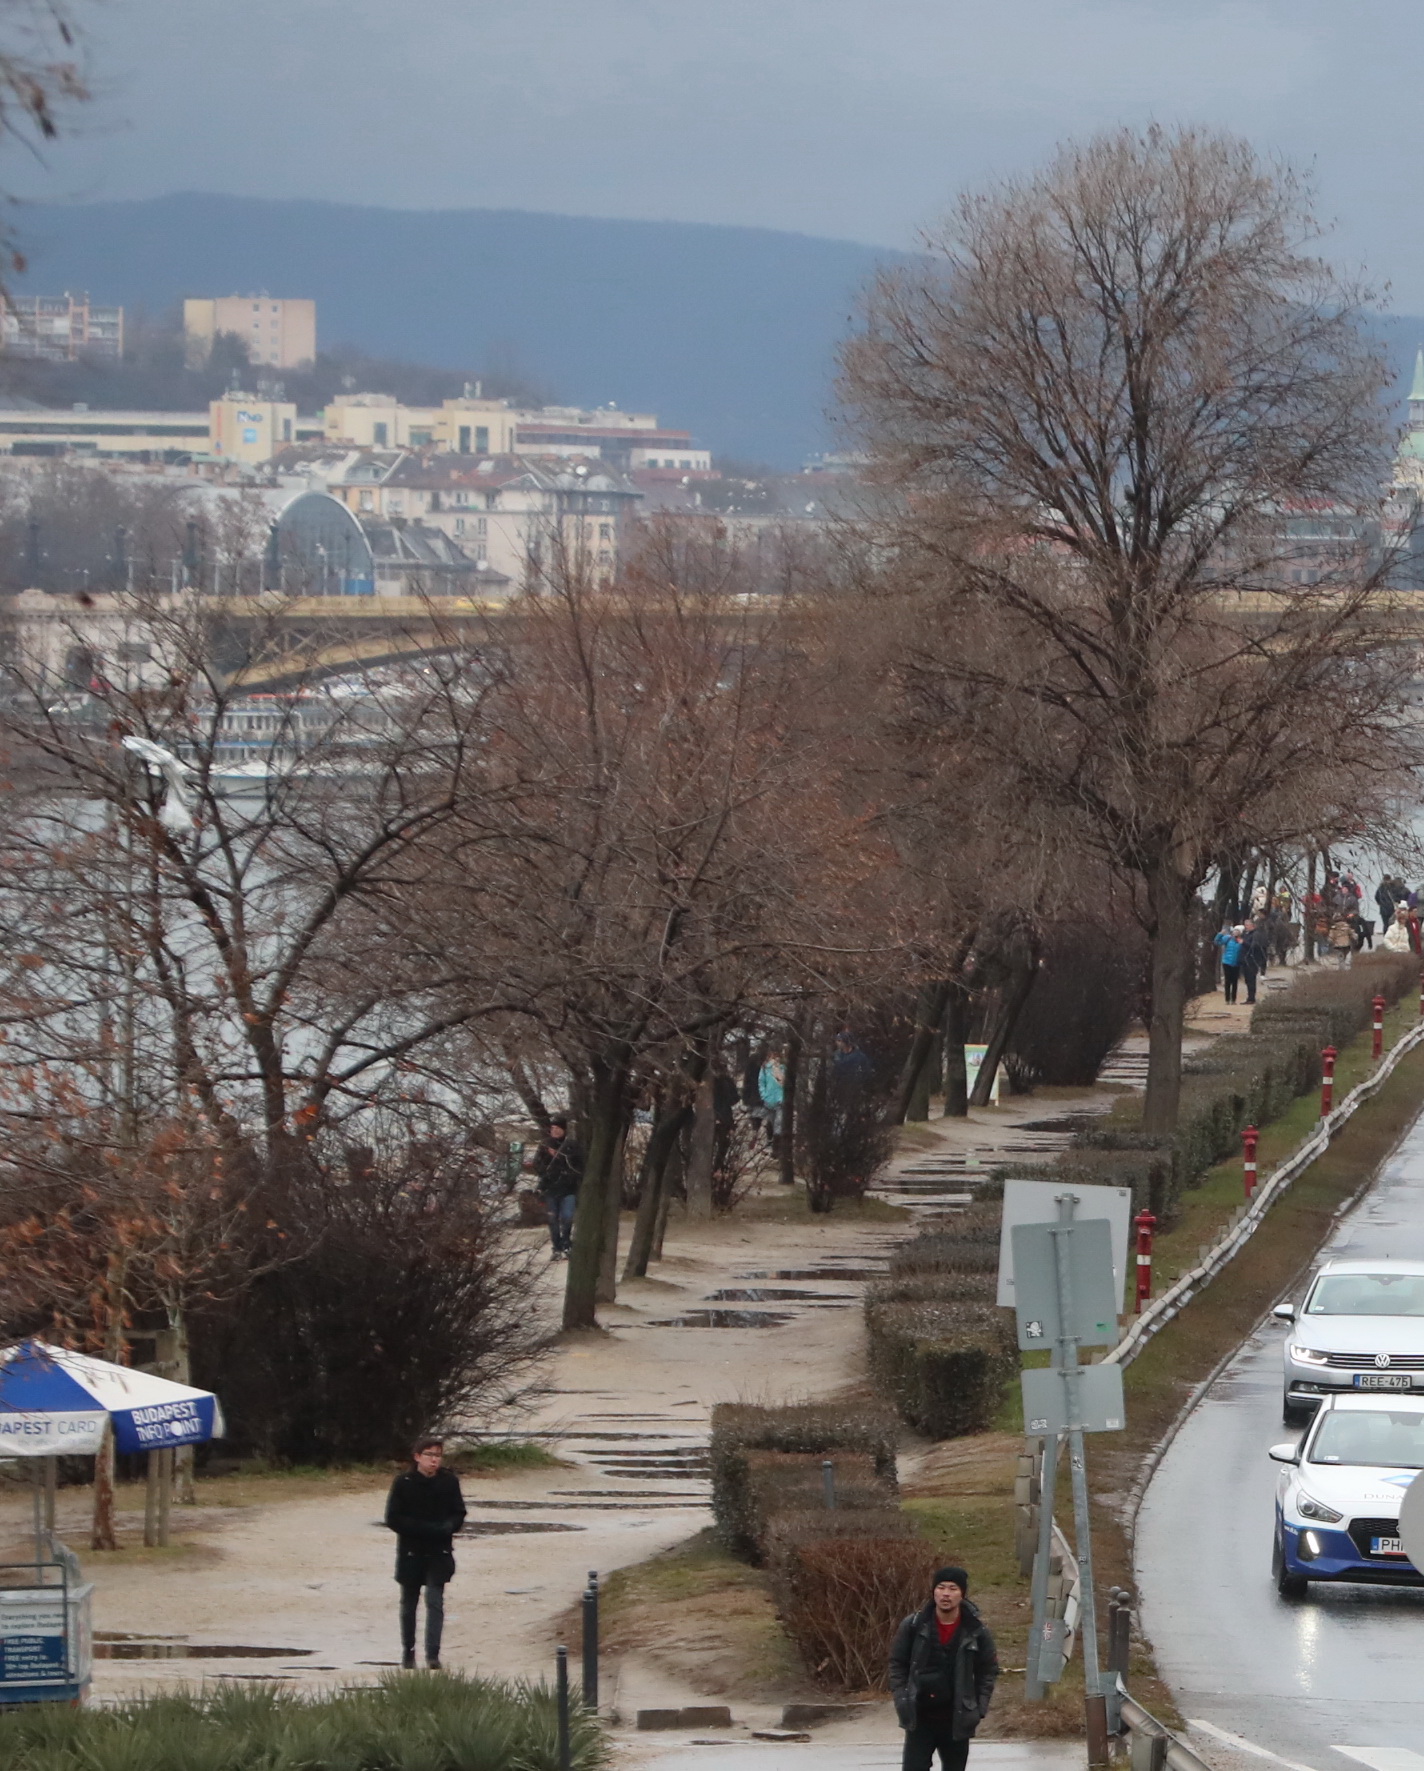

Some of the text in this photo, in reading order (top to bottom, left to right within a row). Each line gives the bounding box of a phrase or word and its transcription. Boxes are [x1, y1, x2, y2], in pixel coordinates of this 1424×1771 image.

[1361, 1376, 1408, 1387] REE-475
[131, 1401, 197, 1425] BUDAPEST
[0, 1421, 97, 1435] APEST CARD
[1381, 1539, 1404, 1552] PH
